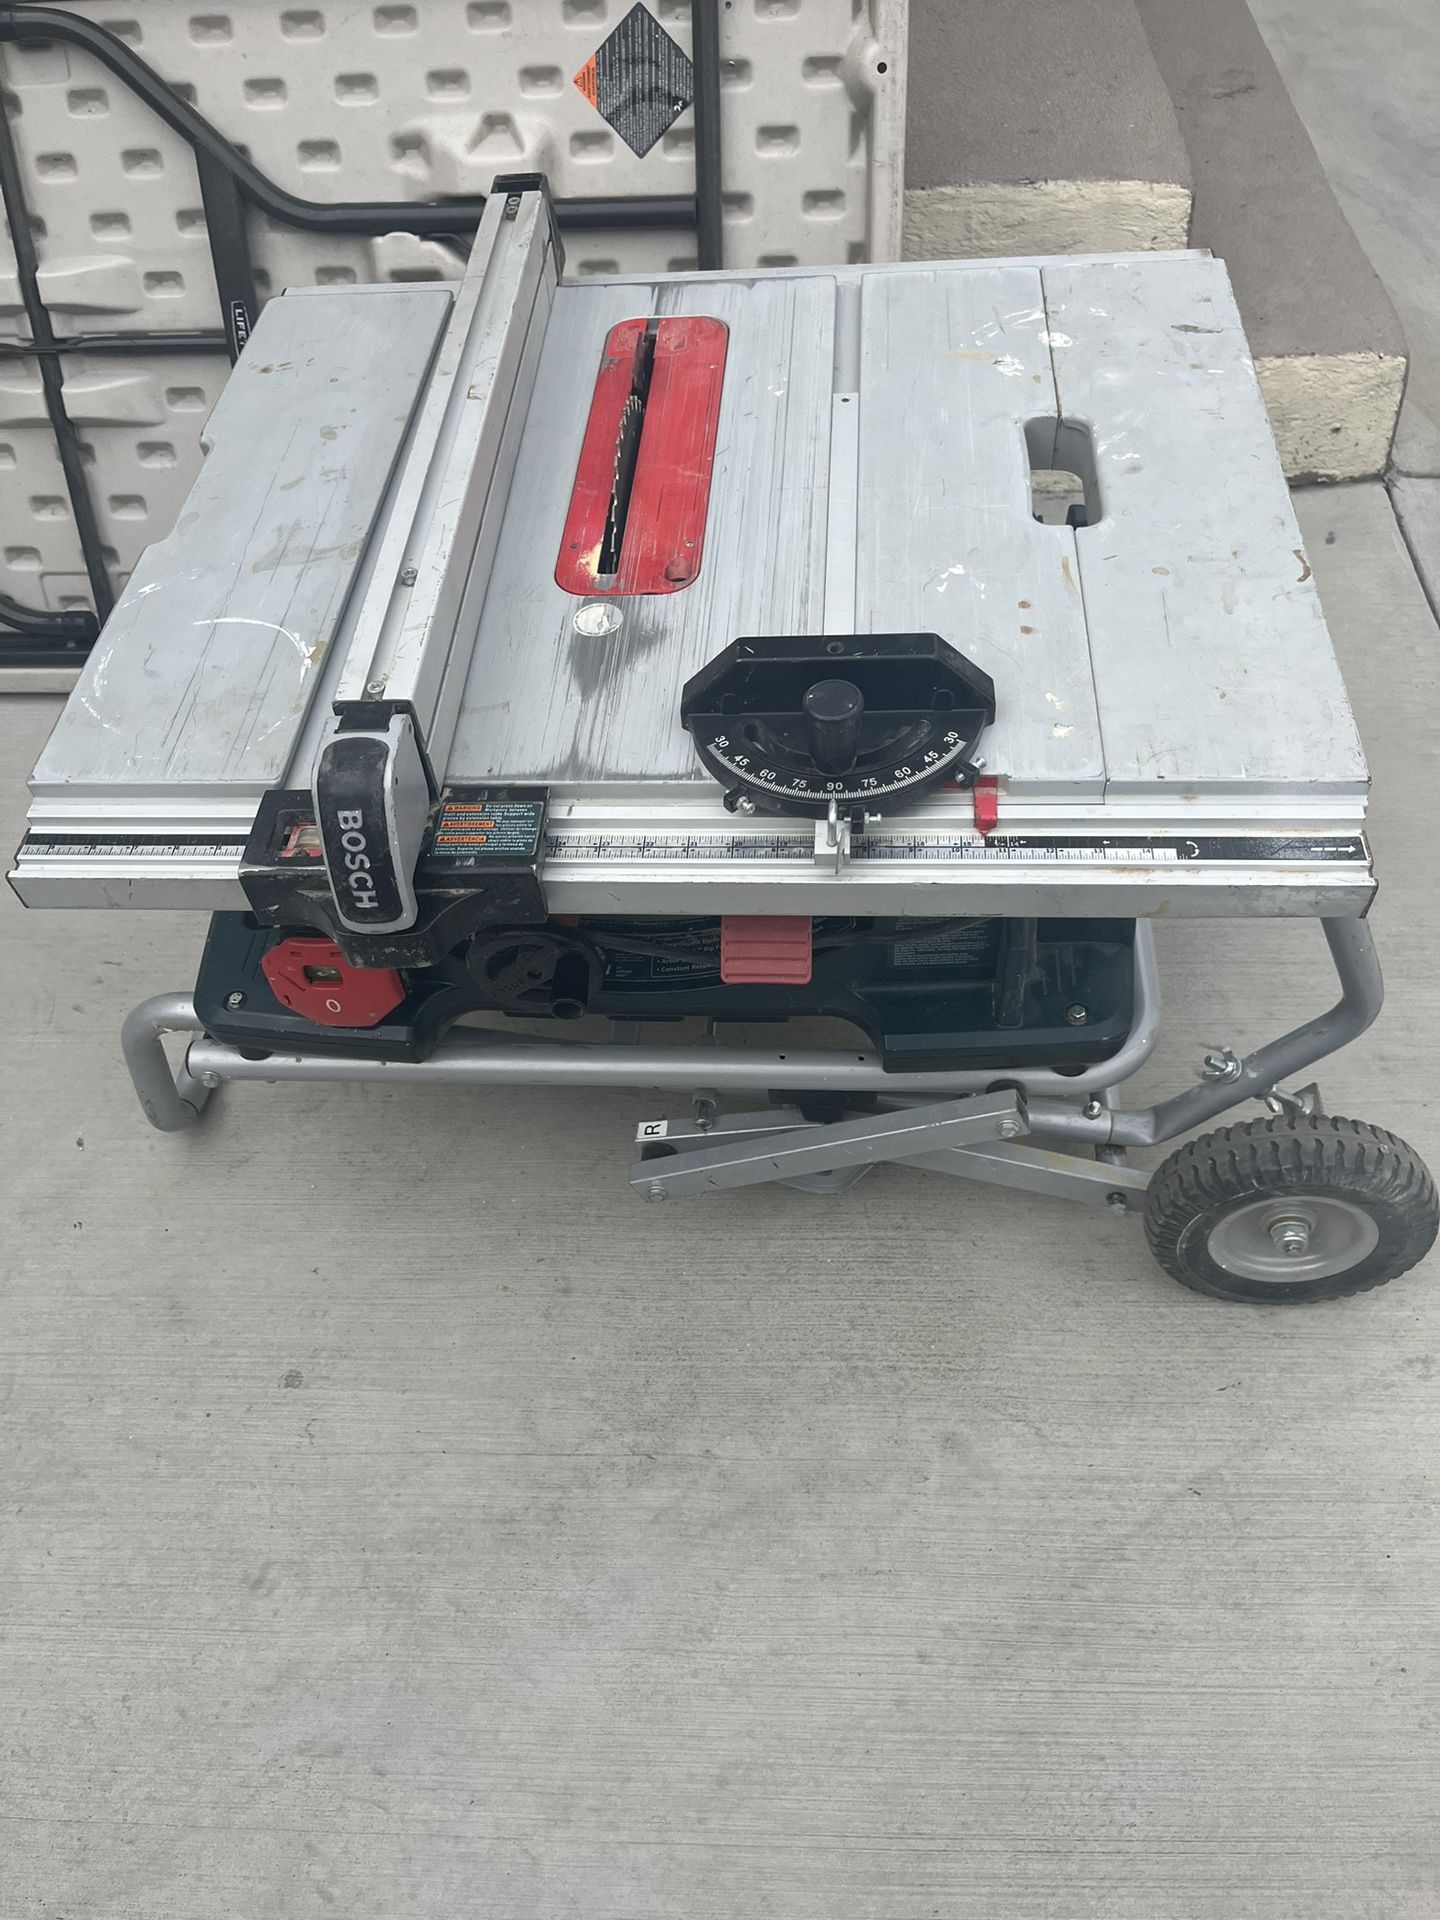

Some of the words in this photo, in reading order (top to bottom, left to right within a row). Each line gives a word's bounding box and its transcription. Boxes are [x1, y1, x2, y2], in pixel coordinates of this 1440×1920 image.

[714, 735, 729, 748] 30
[734, 753, 750, 767] 45
[759, 768, 776, 781] 60
[792, 777, 807, 789] 75
[826, 782, 843, 791] 90
[861, 777, 877, 788] 75
[894, 766, 912, 779] 60
[922, 751, 939, 763] 45
[944, 731, 959, 745] 30
[337, 808, 379, 908] BOSCH
[644, 1124, 661, 1135] R
